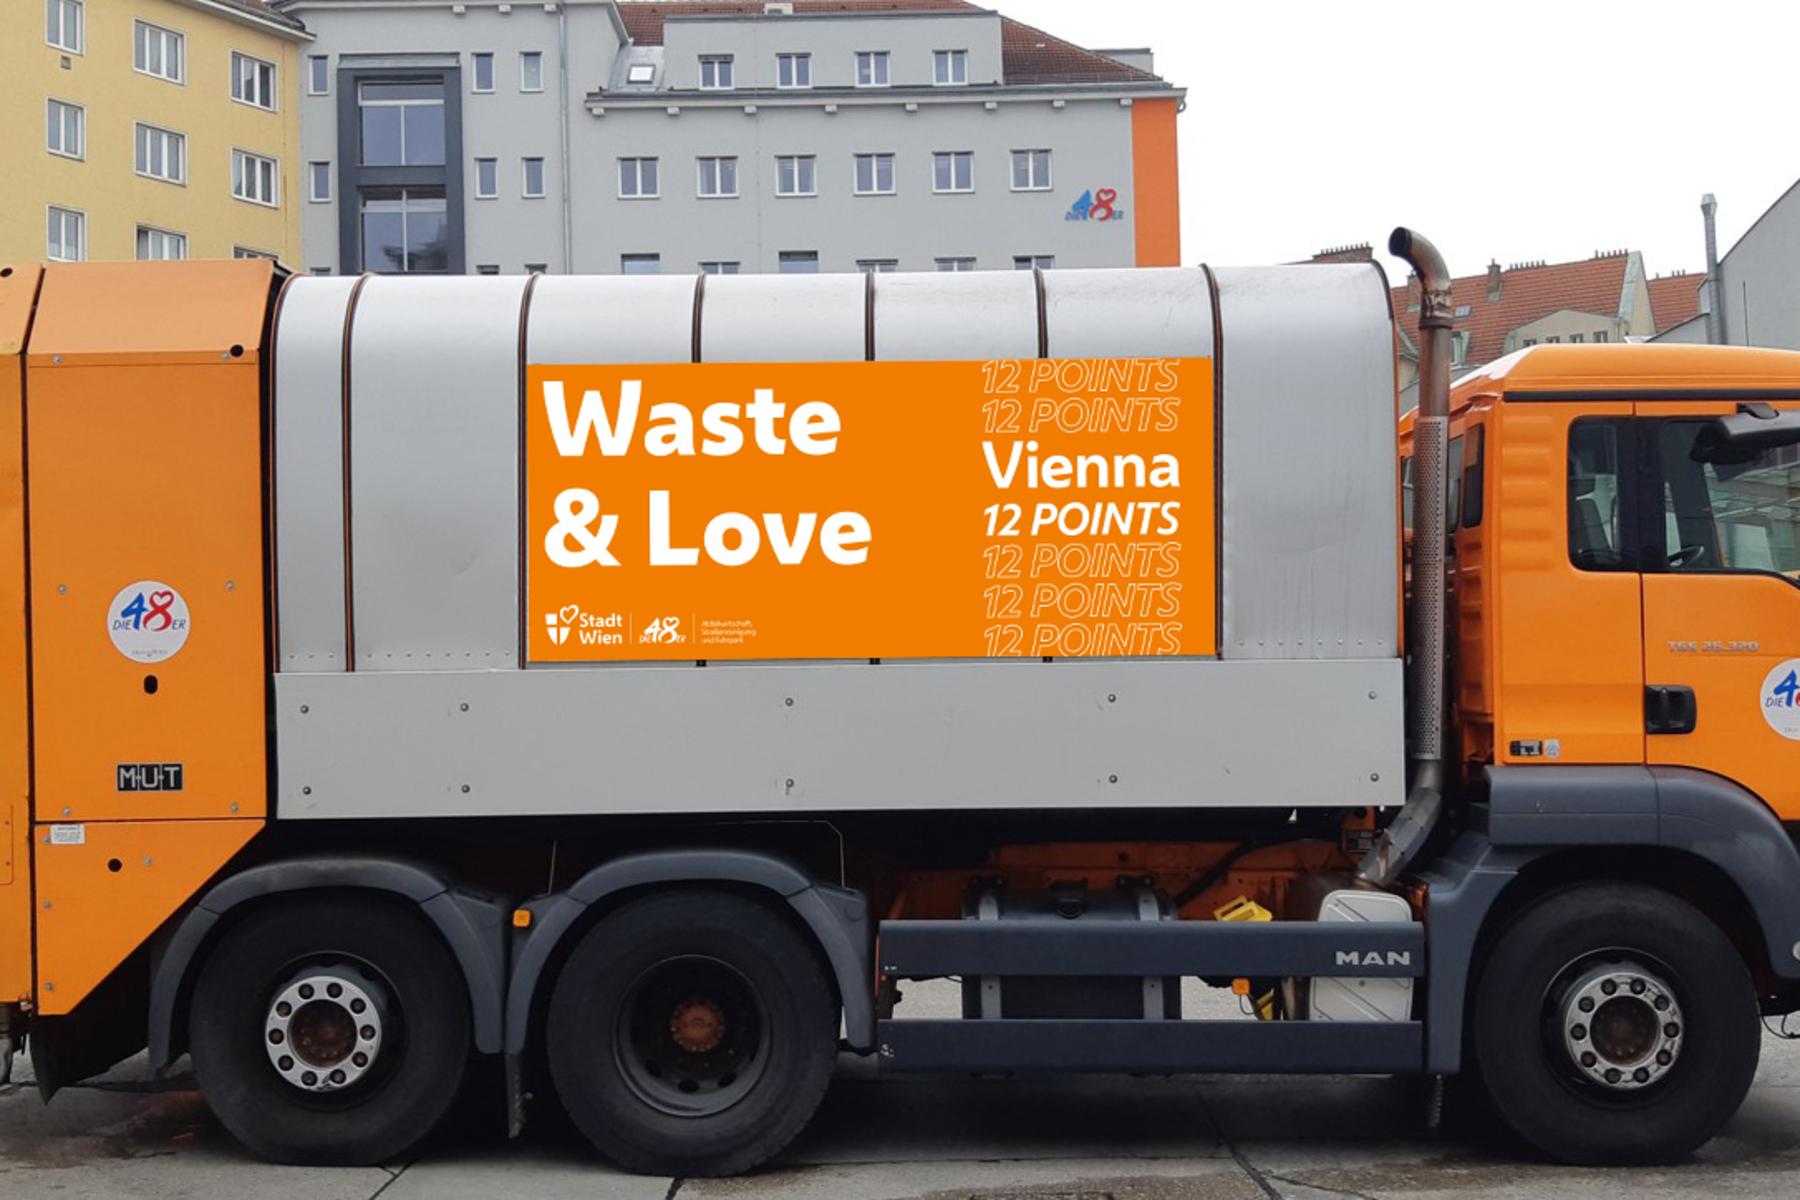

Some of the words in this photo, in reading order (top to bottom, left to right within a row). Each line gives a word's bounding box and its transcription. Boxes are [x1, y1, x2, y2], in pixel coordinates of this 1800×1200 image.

[982, 359, 1022, 394] 12
[1028, 359, 1181, 394] POINTS
[542, 379, 842, 457] Waste
[982, 397, 1022, 433] 12
[1028, 397, 1181, 433] POINTS
[981, 440, 1181, 489] Vienna
[543, 487, 622, 568] &
[648, 489, 873, 567] Love
[984, 502, 1022, 536] 12
[1030, 500, 1181, 536] POINTS
[983, 543, 1023, 578] 12
[1030, 541, 1182, 578] POINTS
[983, 583, 1023, 618] 12
[1031, 581, 1183, 618] POINTS
[579, 612, 623, 629] Stadt
[579, 629, 623, 645] Wien
[984, 623, 1024, 656] 12
[1031, 622, 1183, 656] POINTS
[1774, 669, 1800, 708] 4
[1335, 950, 1411, 966] MAN
